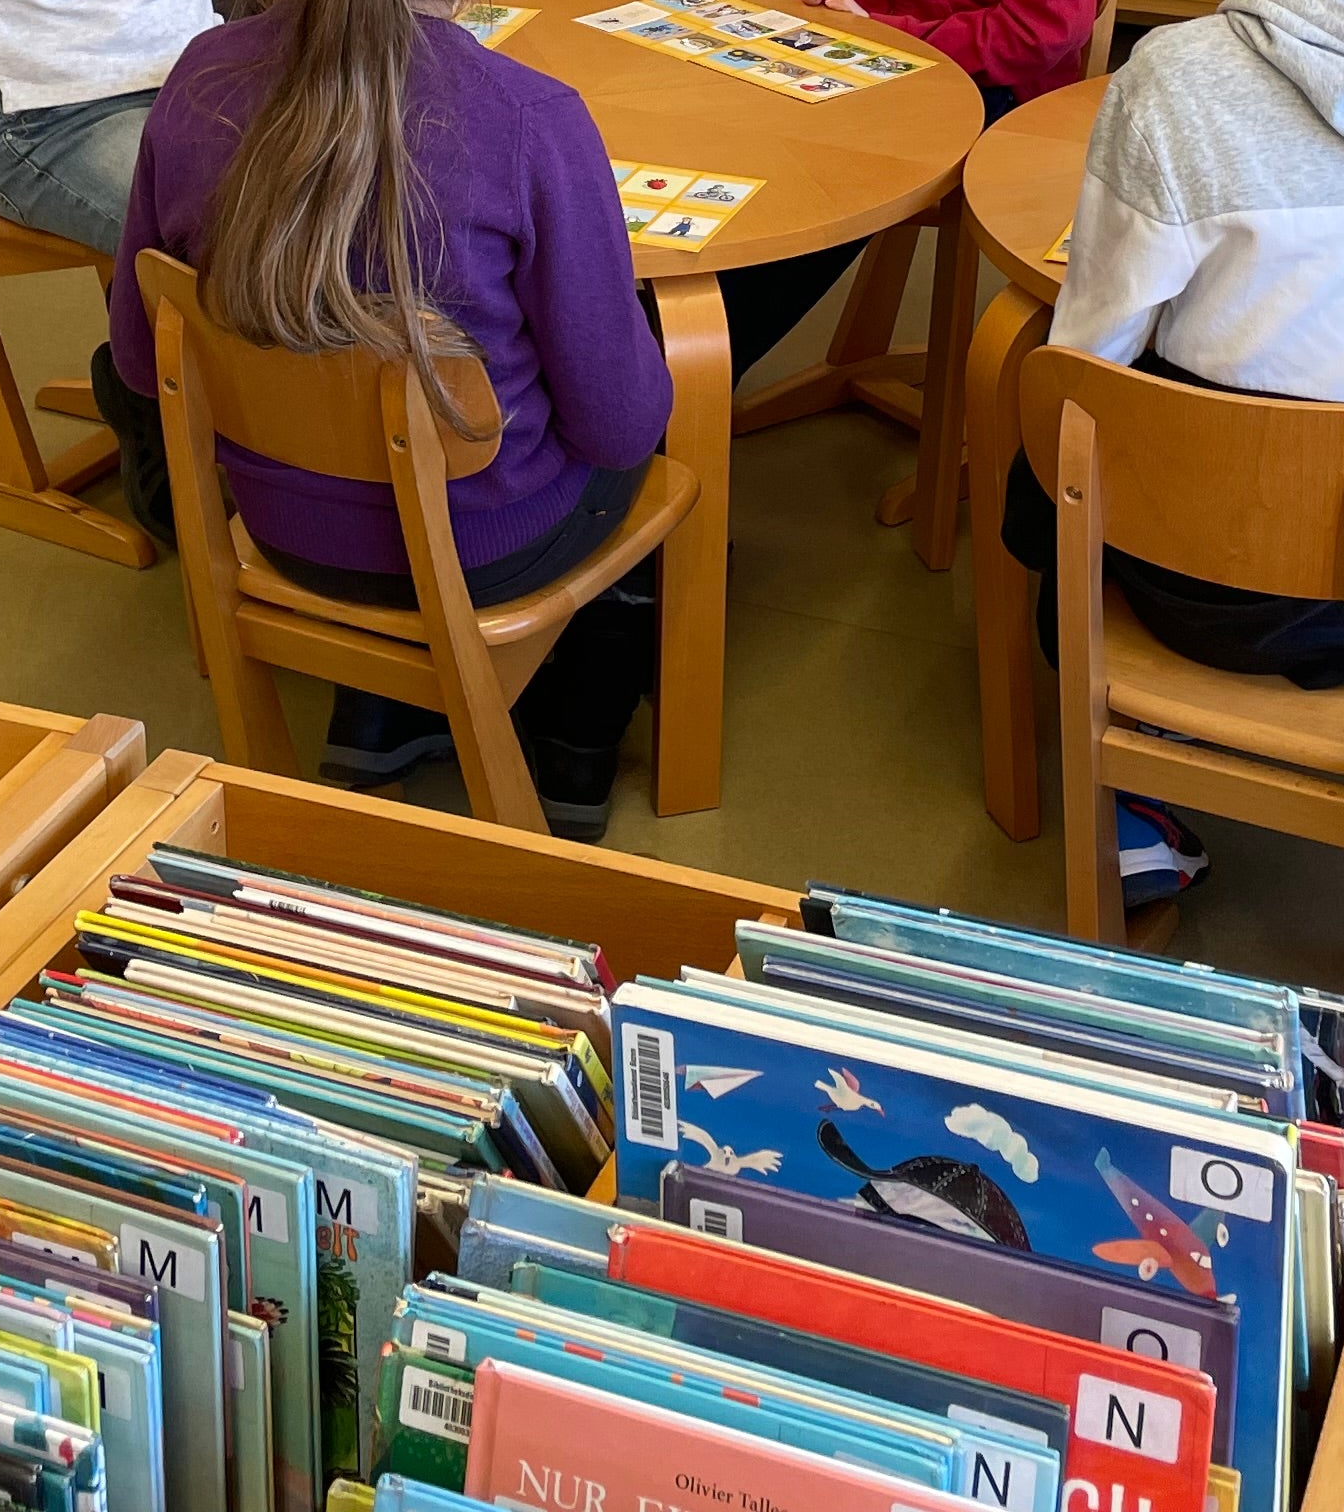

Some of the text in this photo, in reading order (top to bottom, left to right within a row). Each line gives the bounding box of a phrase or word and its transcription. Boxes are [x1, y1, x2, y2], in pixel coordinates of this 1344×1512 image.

[316, 1179, 352, 1225] M
[1200, 1159, 1244, 1201] O
[139, 1239, 177, 1289] M
[1105, 1393, 1146, 1450] N
[515, 1459, 607, 1512] NUR
[675, 1473, 734, 1505] Olivier
[971, 1451, 1012, 1508] N
